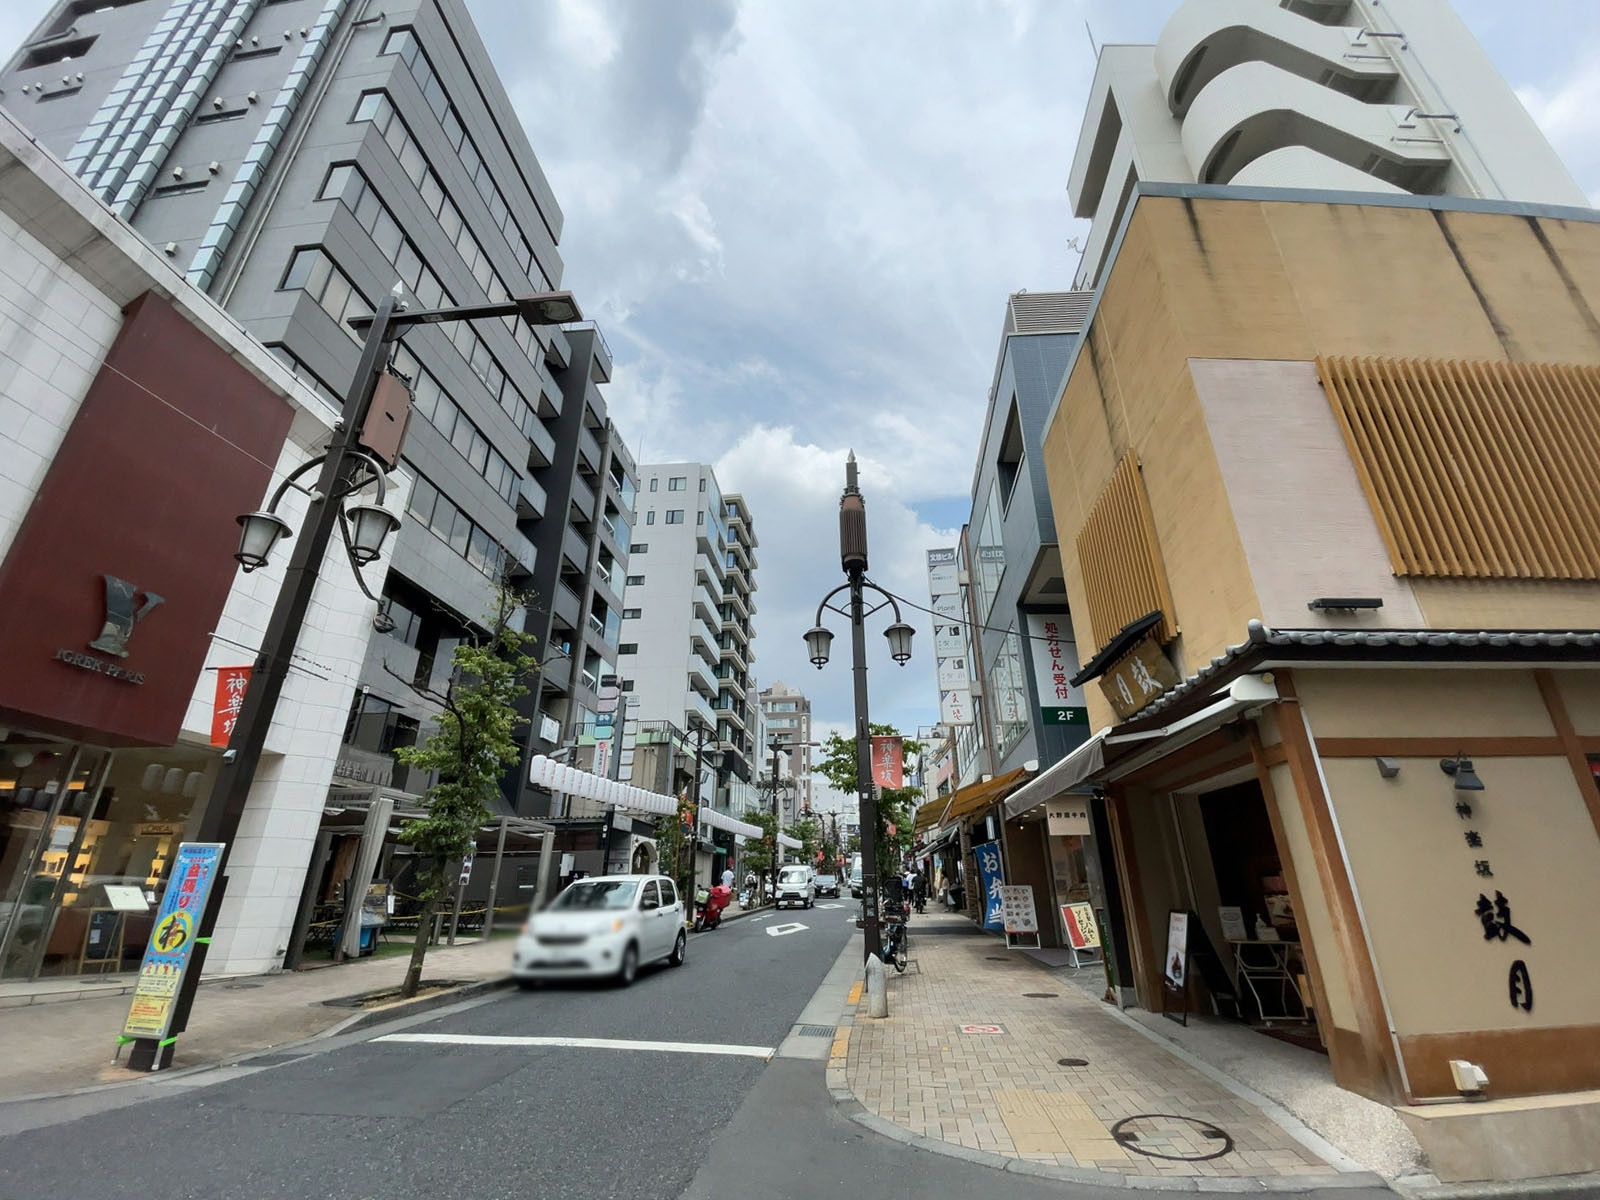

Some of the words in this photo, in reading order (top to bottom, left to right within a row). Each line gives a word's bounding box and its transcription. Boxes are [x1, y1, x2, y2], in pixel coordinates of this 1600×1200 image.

[1044, 622, 1069, 699] 処方せん受付
[1057, 711, 1075, 721] 2F
[875, 740, 898, 787] 神楽坂
[1456, 802, 1494, 878] 神楽坂
[983, 852, 1005, 925] お弁当
